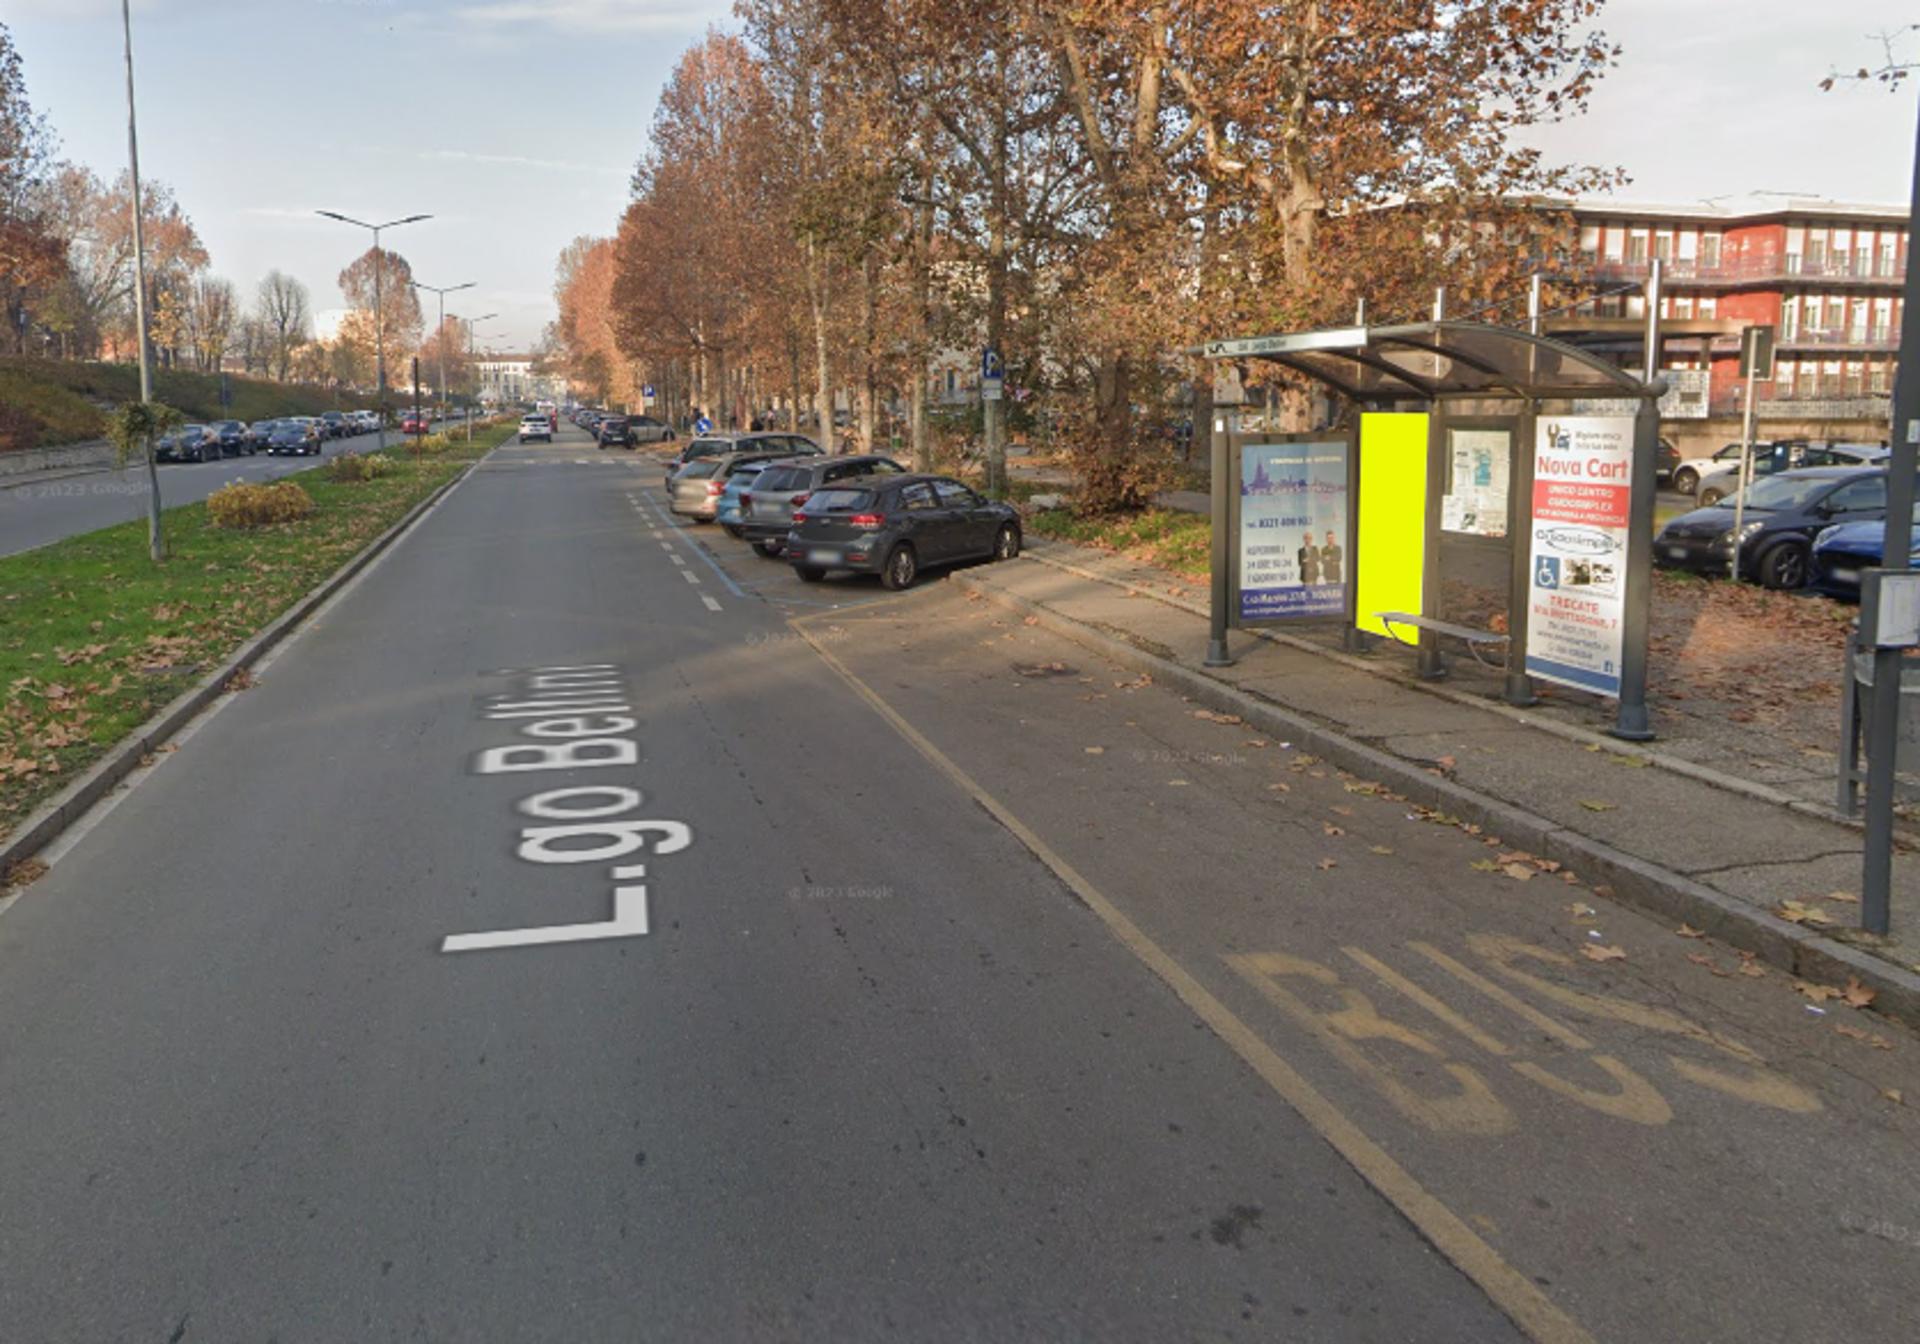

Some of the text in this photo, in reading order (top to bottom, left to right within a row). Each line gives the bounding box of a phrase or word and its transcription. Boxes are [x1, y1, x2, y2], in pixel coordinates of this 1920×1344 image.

[1538, 455, 1628, 479] Nova Cart
[476, 663, 638, 774] Bellini
[1218, 931, 1825, 1135] BUS
